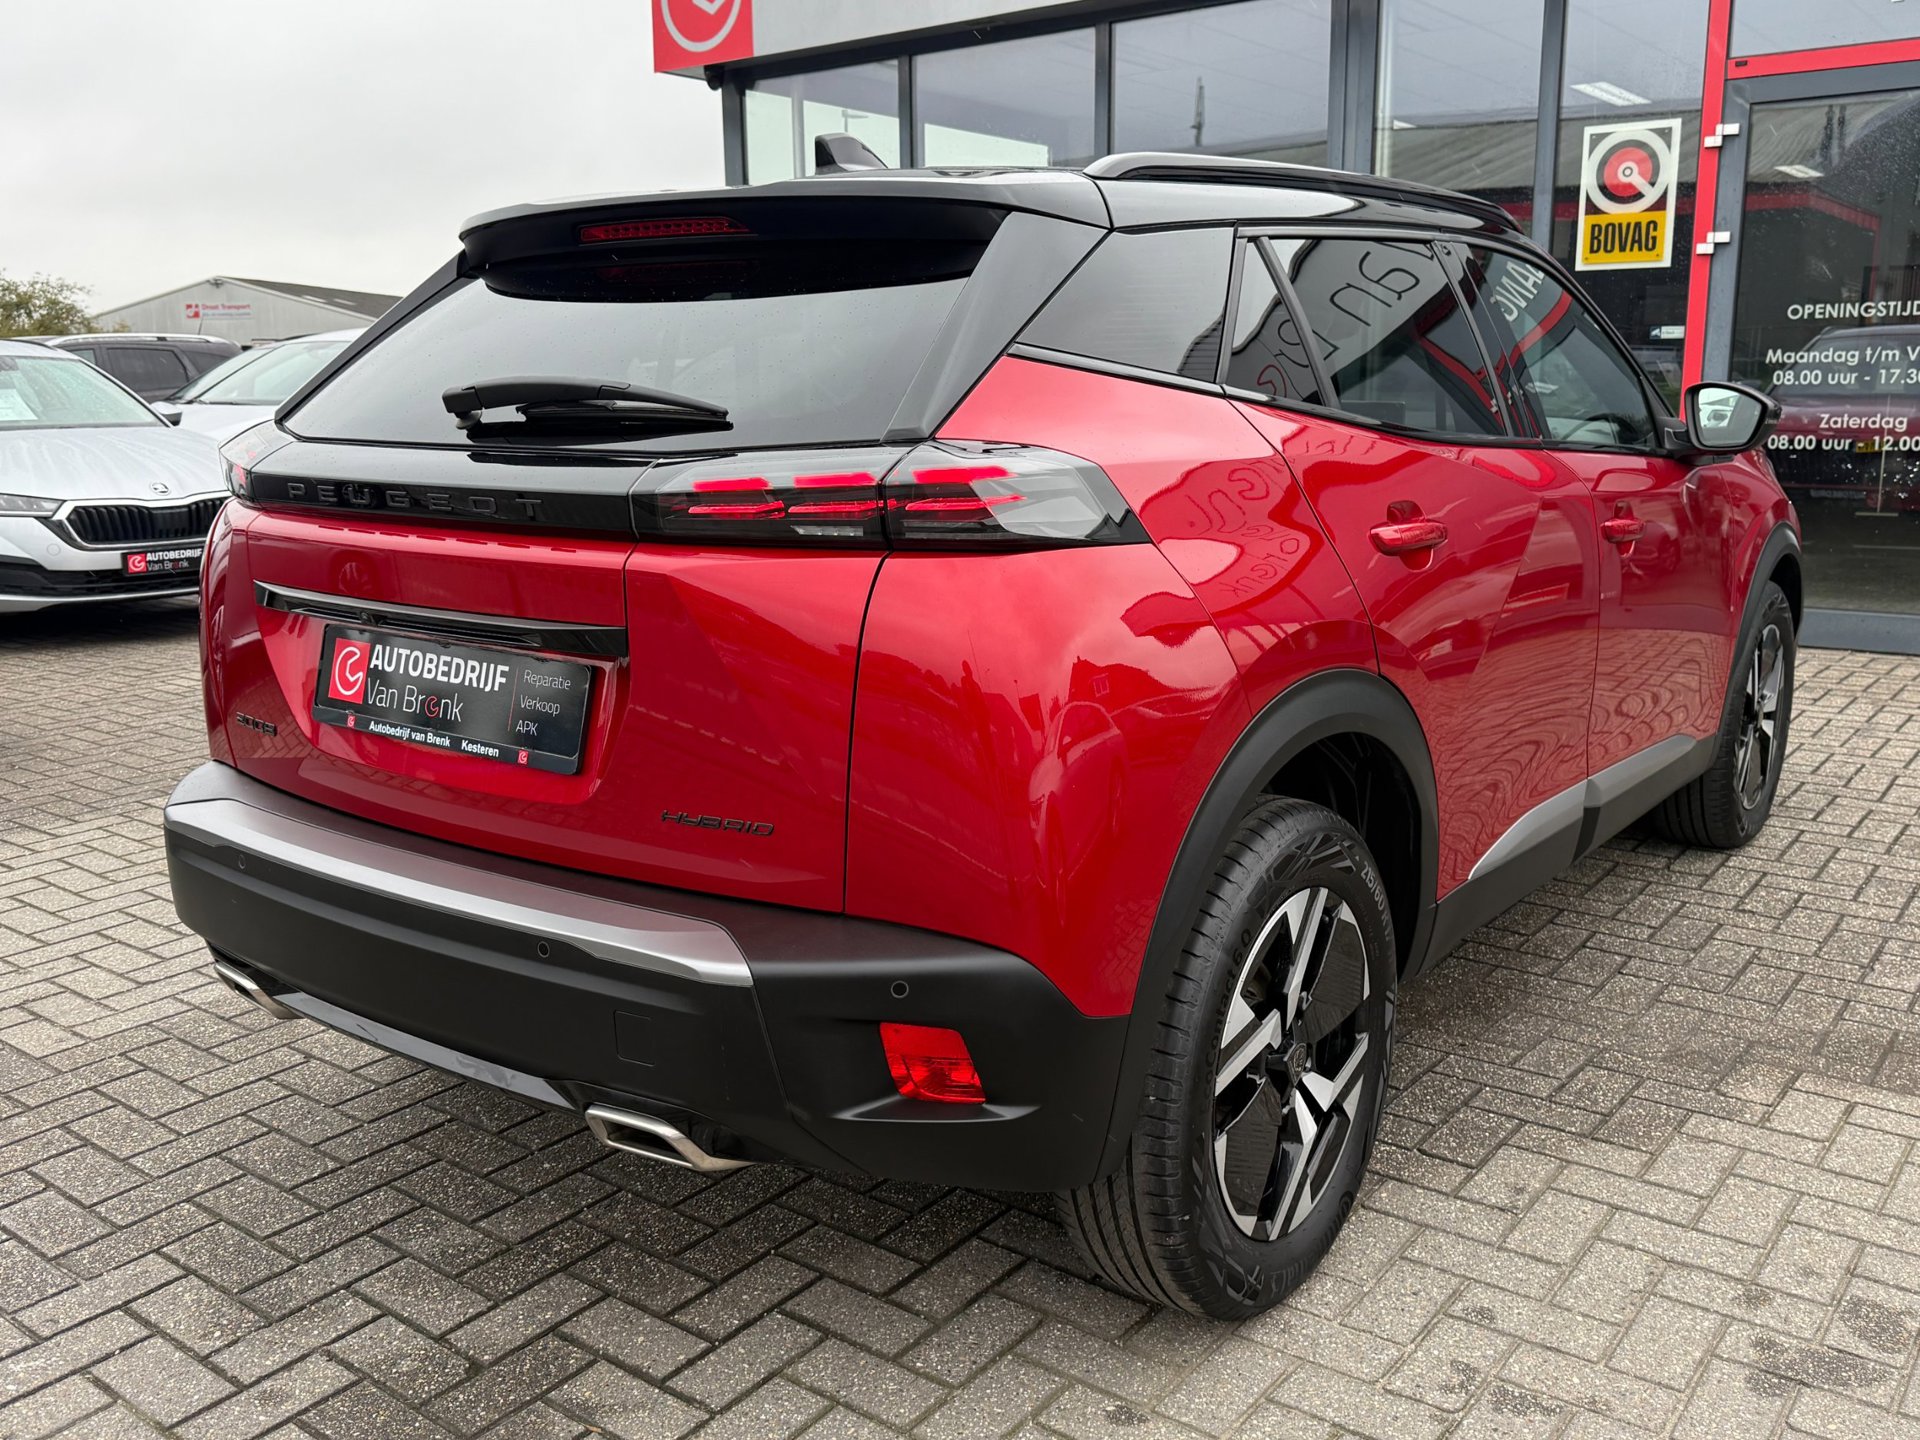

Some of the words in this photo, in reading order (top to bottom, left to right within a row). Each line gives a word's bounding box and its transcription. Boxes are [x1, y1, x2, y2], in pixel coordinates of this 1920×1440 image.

[1589, 220, 1658, 255] BOVAG
[1765, 347, 1860, 366] Maandag
[1865, 345, 1900, 364] t/m
[1773, 369, 1822, 385] 08.00
[1827, 371, 1858, 385] uur
[1879, 368, 1920, 384] 17.3
[1819, 413, 1908, 433] Zaterdag
[1767, 434, 1817, 450] 08.00
[1822, 437, 1852, 450] uur
[287, 482, 542, 520] PEUGEOT
[146, 547, 203, 561] AUTOBEDRIJF
[147, 562, 163, 571] Van
[370, 643, 510, 693] AUTOBEDRIJF
[523, 669, 572, 690] Reparatie
[367, 677, 399, 710] Van
[402, 684, 464, 722] Brenk
[520, 694, 561, 717] Verkoop
[515, 719, 539, 737] APK
[368, 720, 411, 741] Autobedrijf
[410, 730, 426, 742] van
[426, 732, 451, 748] Brenk
[461, 739, 500, 758] Kesteren
[661, 809, 775, 837] HYBRID
